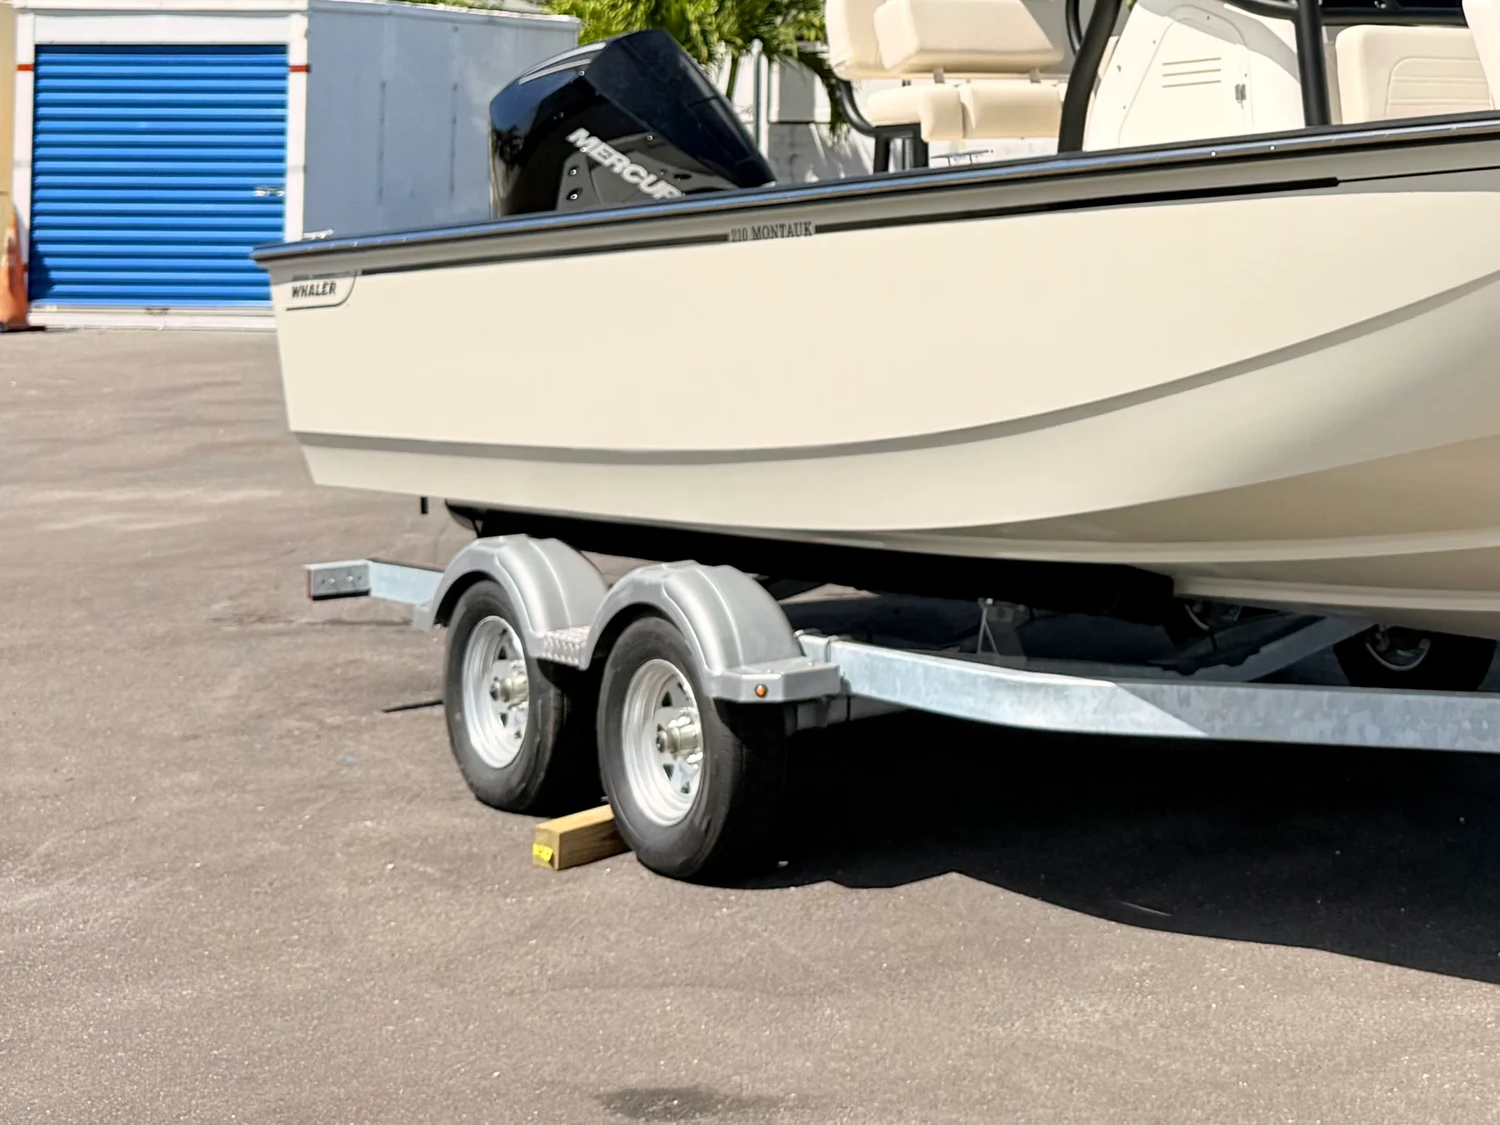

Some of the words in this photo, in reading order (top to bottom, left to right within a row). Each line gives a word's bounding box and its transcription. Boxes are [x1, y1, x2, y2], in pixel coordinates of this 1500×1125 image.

[565, 127, 686, 200] MERCUR
[731, 227, 748, 243] 210
[751, 221, 813, 241] MONTAUK
[291, 282, 336, 299] WHALER
